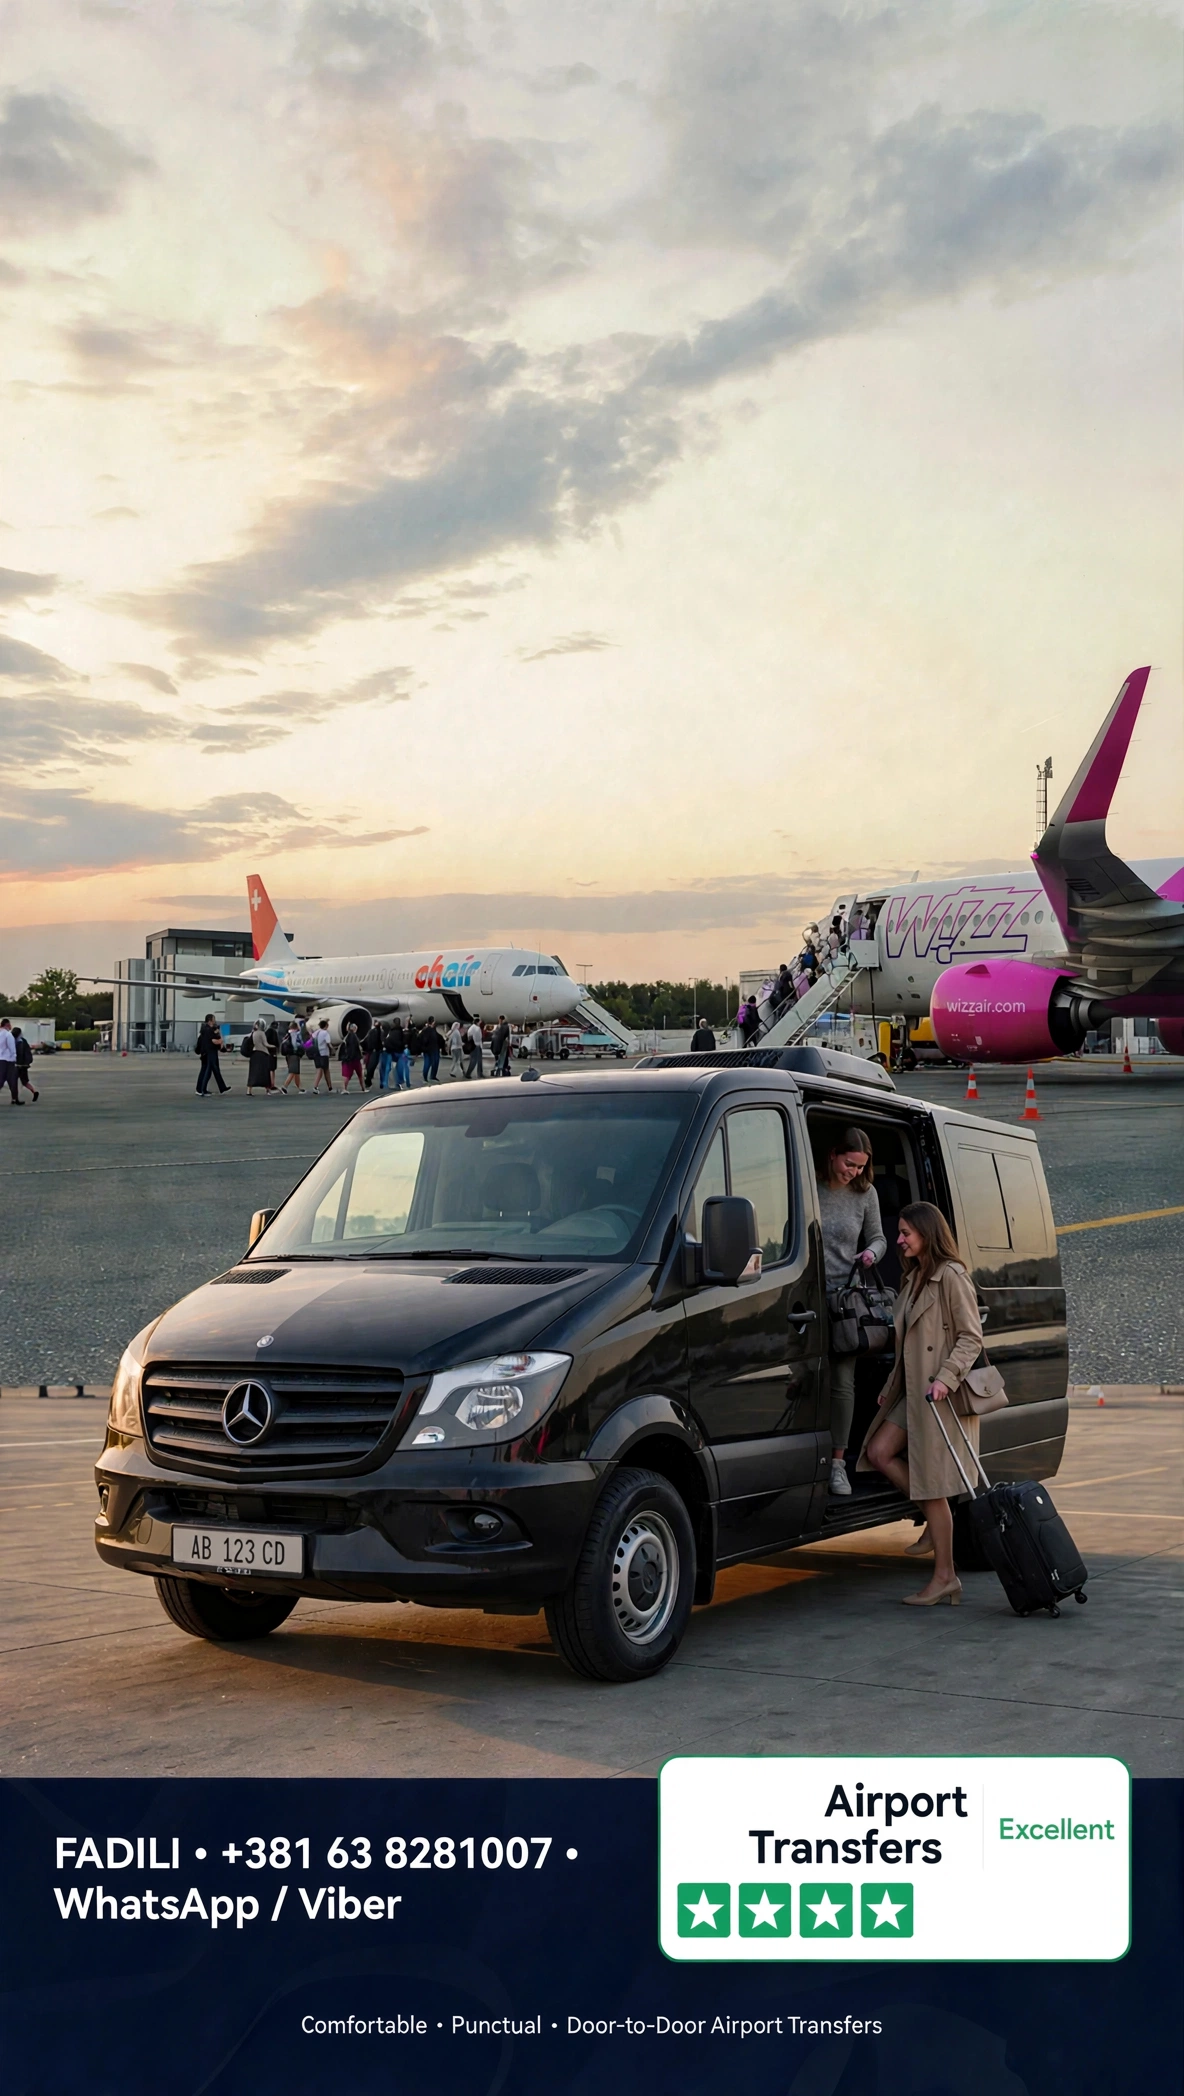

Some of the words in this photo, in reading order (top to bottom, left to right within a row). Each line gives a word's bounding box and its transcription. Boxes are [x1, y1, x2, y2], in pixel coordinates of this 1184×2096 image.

[946, 998, 1026, 1013] wizzair.com
[191, 1535, 212, 1560] AB
[223, 1537, 255, 1564] 123
[262, 1540, 285, 1566] CD
